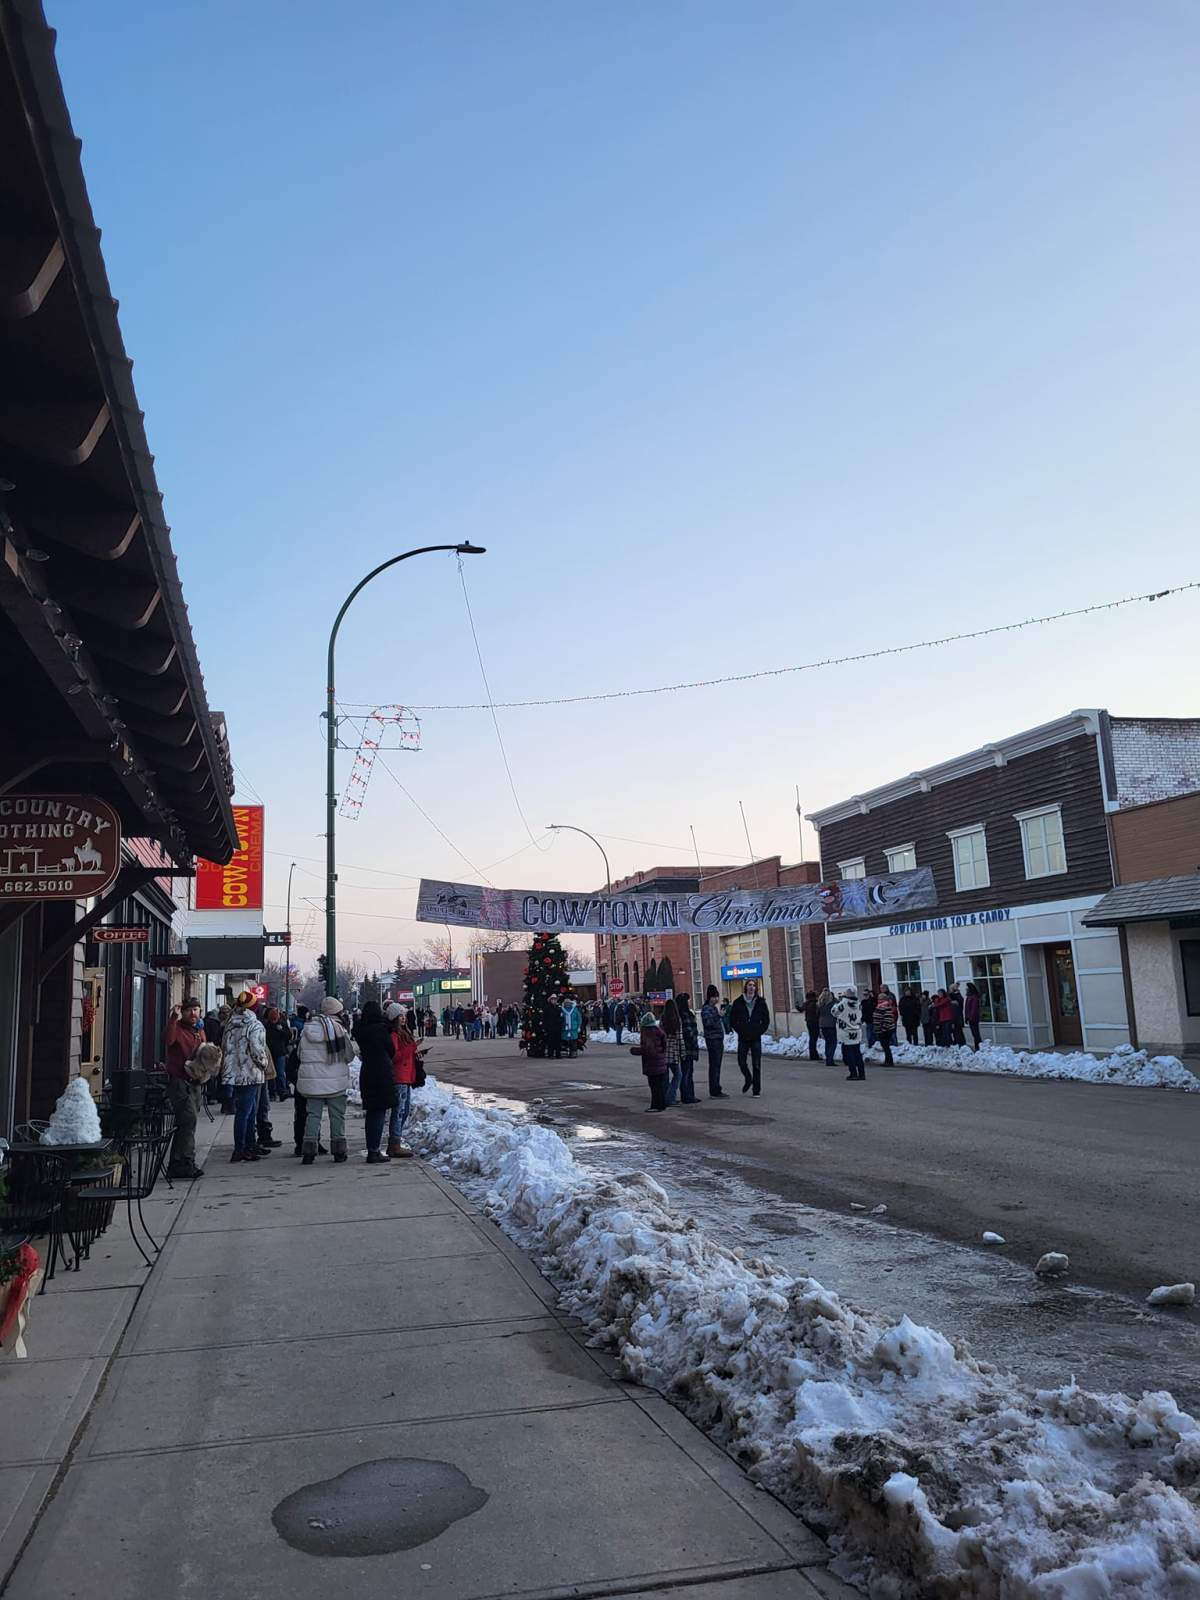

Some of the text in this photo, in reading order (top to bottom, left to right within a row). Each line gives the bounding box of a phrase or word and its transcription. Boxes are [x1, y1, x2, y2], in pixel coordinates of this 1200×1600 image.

[0, 799, 112, 834] COUNTRY
[250, 810, 262, 872] CINEMA
[522, 895, 818, 928] COWTOWN Christmas
[889, 909, 1011, 936] COWTOWN KIDS TOY & CANDY
[609, 982, 624, 990] STOP
